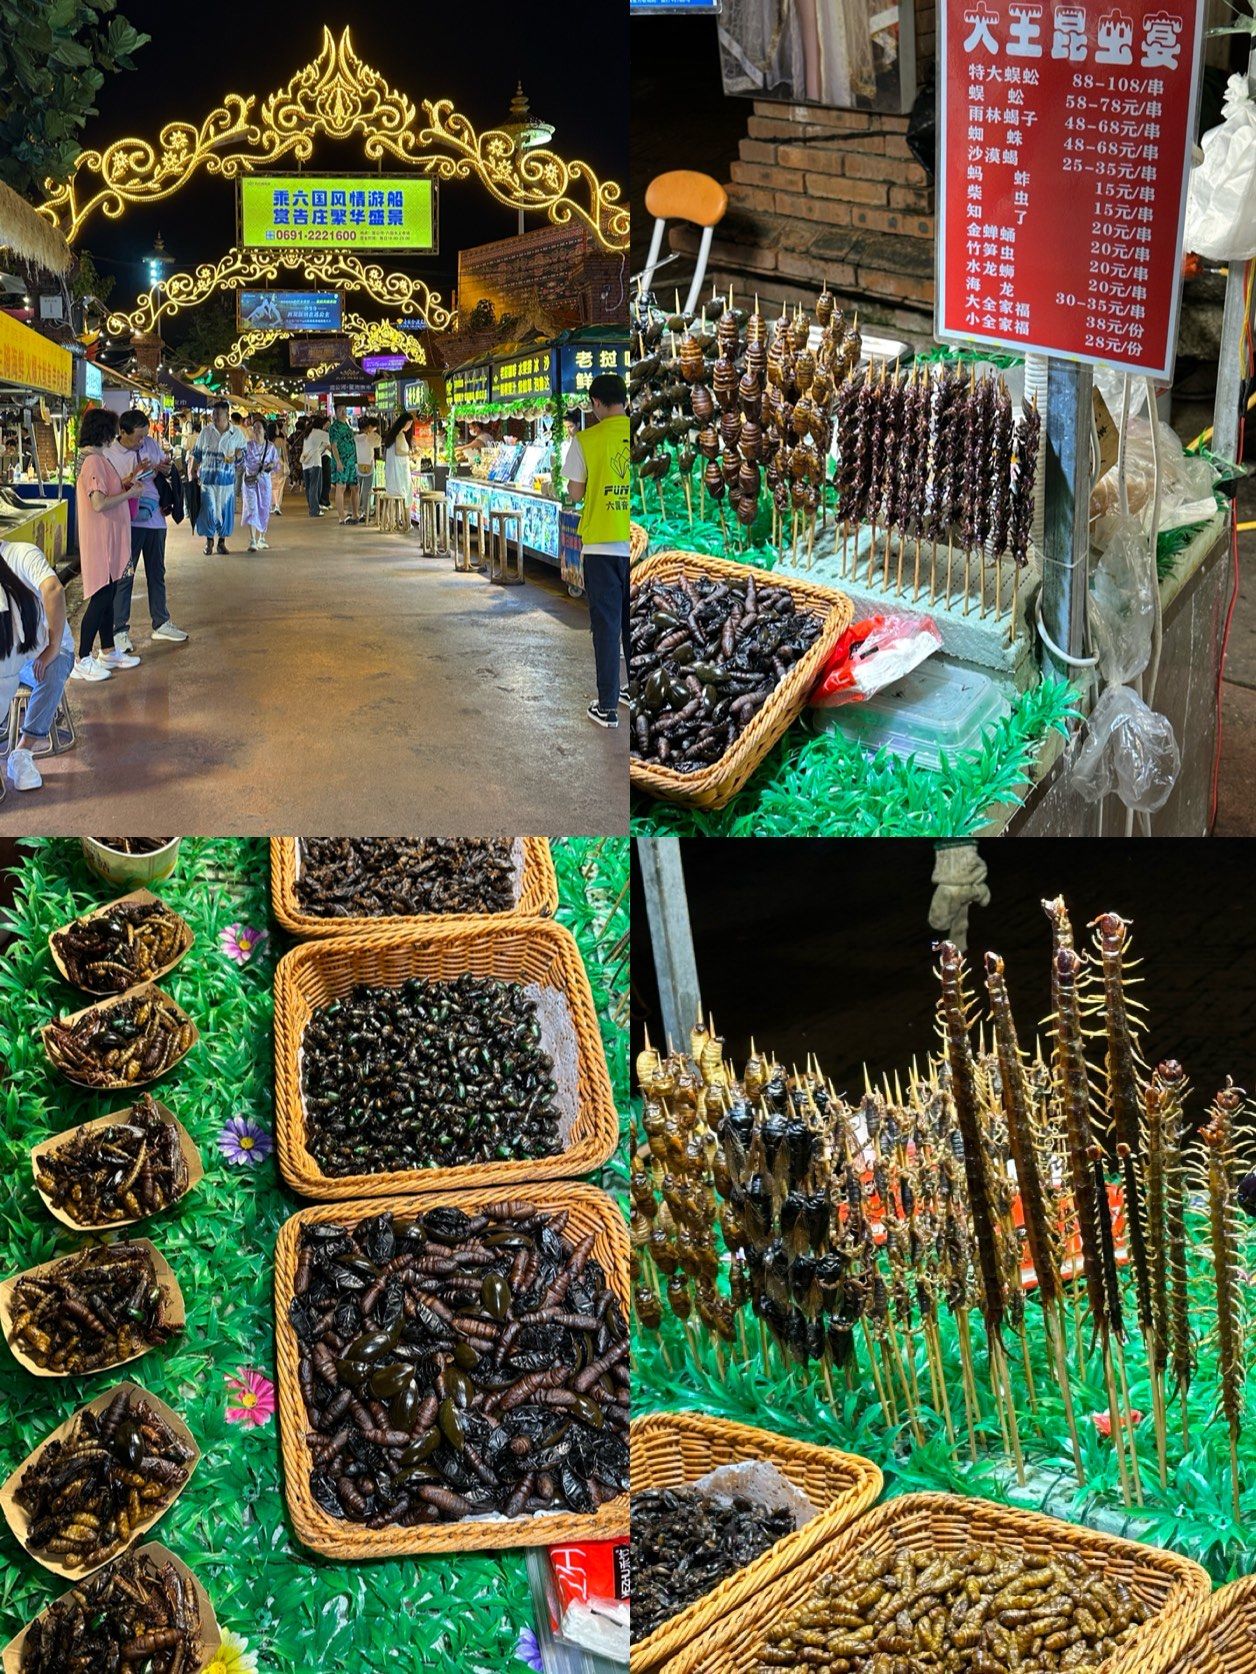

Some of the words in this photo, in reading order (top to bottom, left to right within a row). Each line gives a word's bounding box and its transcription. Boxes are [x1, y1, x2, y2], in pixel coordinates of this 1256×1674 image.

[963, 1, 1183, 71] 大王昆虫宴
[968, 63, 1039, 85] 特大蜈蚣
[1072, 74, 1165, 95] 88-108/串
[1066, 94, 1163, 118] 58-78元/串
[968, 105, 1038, 126] 雨林蝎子
[1064, 117, 1161, 139] 48-68元/串
[1063, 138, 1159, 161] 48-68元/串
[968, 147, 1018, 166] 沙漠蝎
[1062, 158, 1158, 182] 25-35元/串
[273, 190, 403, 207] 乘六国风情游船
[1095, 182, 1156, 202] 15元/串
[273, 209, 403, 226] 赏告庄繁华盛景
[1093, 202, 1154, 223] 15元/串
[276, 230, 357, 240] 0691-2221600
[966, 223, 1016, 243] 金蝉蛹
[1090, 242, 1151, 262] 20元/串
[1092, 222, 1152, 243] 20元/串
[966, 241, 1015, 261] 竹笋虫
[1089, 261, 1149, 281] 20元/串
[1088, 280, 1147, 300] 20元/串
[965, 296, 1030, 317] 大全家福
[1085, 316, 1145, 339] 38元/份
[1055, 293, 1146, 319] 30-35元/串
[964, 313, 1030, 335] 小全家福
[1085, 334, 1143, 357] 28元/份
